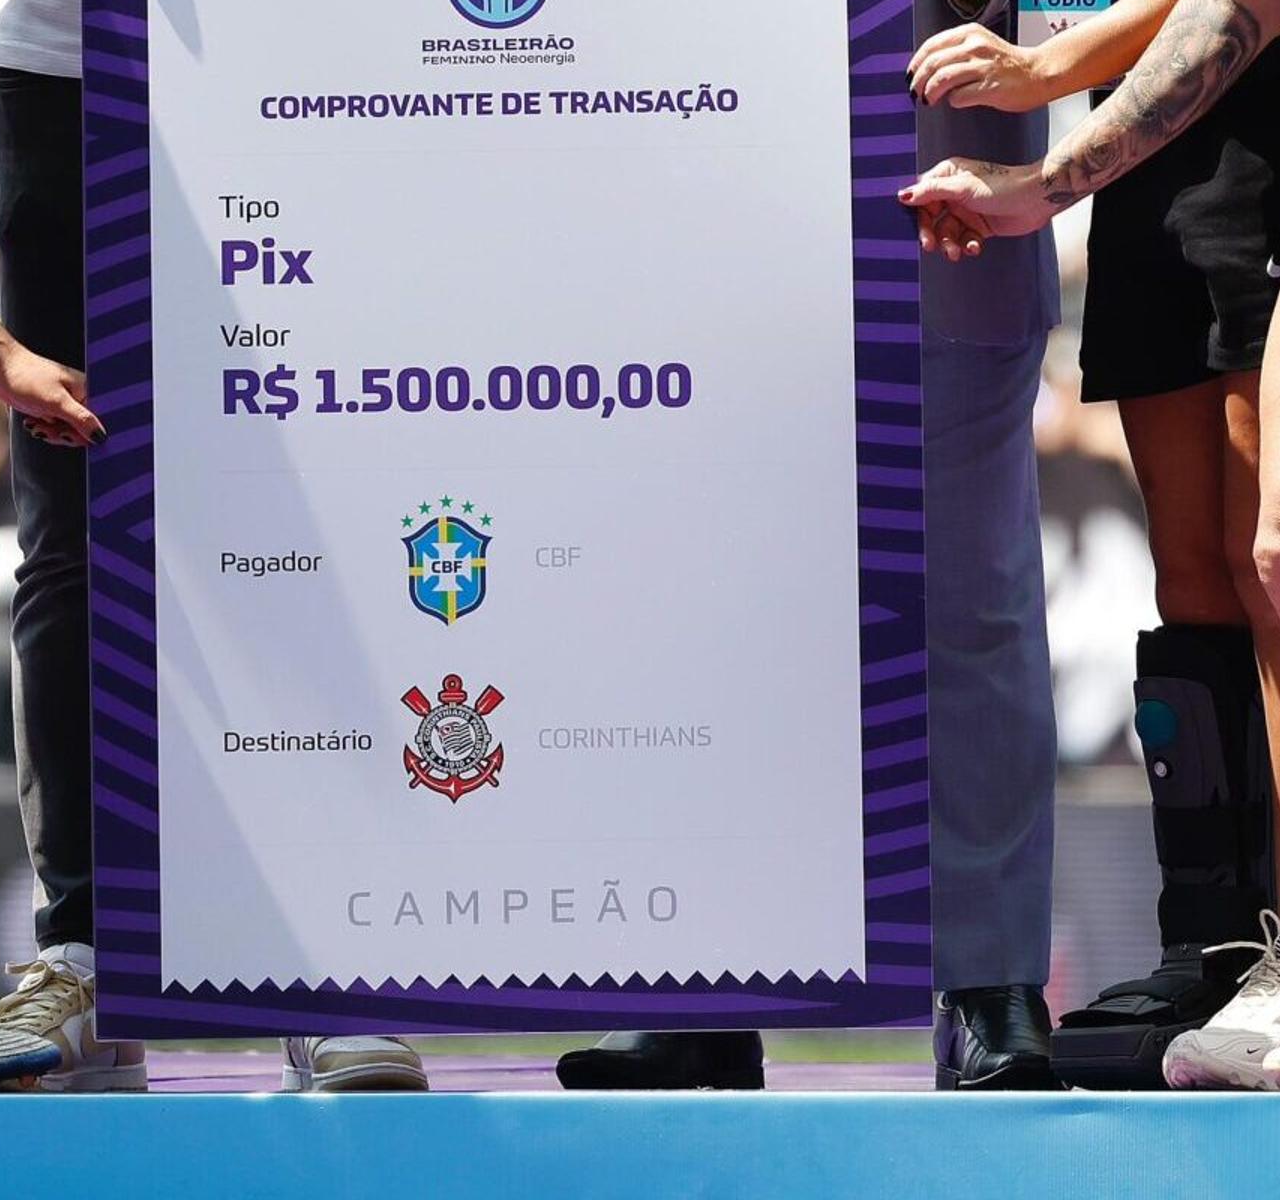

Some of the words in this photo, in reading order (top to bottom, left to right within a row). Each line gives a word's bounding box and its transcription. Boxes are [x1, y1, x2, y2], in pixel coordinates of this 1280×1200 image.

[422, 34, 575, 52] BRASILEIRÃO
[422, 55, 497, 66] FEMININO
[499, 51, 576, 66] Neoenergia
[260, 92, 494, 120] COMPROVANTE
[501, 91, 542, 116] DE
[548, 83, 739, 120] TRANSAÇÃO
[219, 195, 281, 223] Tipo
[221, 236, 314, 286] Pix
[221, 324, 291, 348] Valor
[223, 363, 299, 421] R$
[315, 362, 692, 419] 1.500.000,00
[220, 551, 323, 580] Pagador
[535, 547, 582, 569] CBF
[431, 560, 463, 574] CBF
[223, 728, 373, 754] Destinatário
[537, 725, 713, 751] CORINTHIANS
[347, 879, 679, 928] CAMPEÃO
